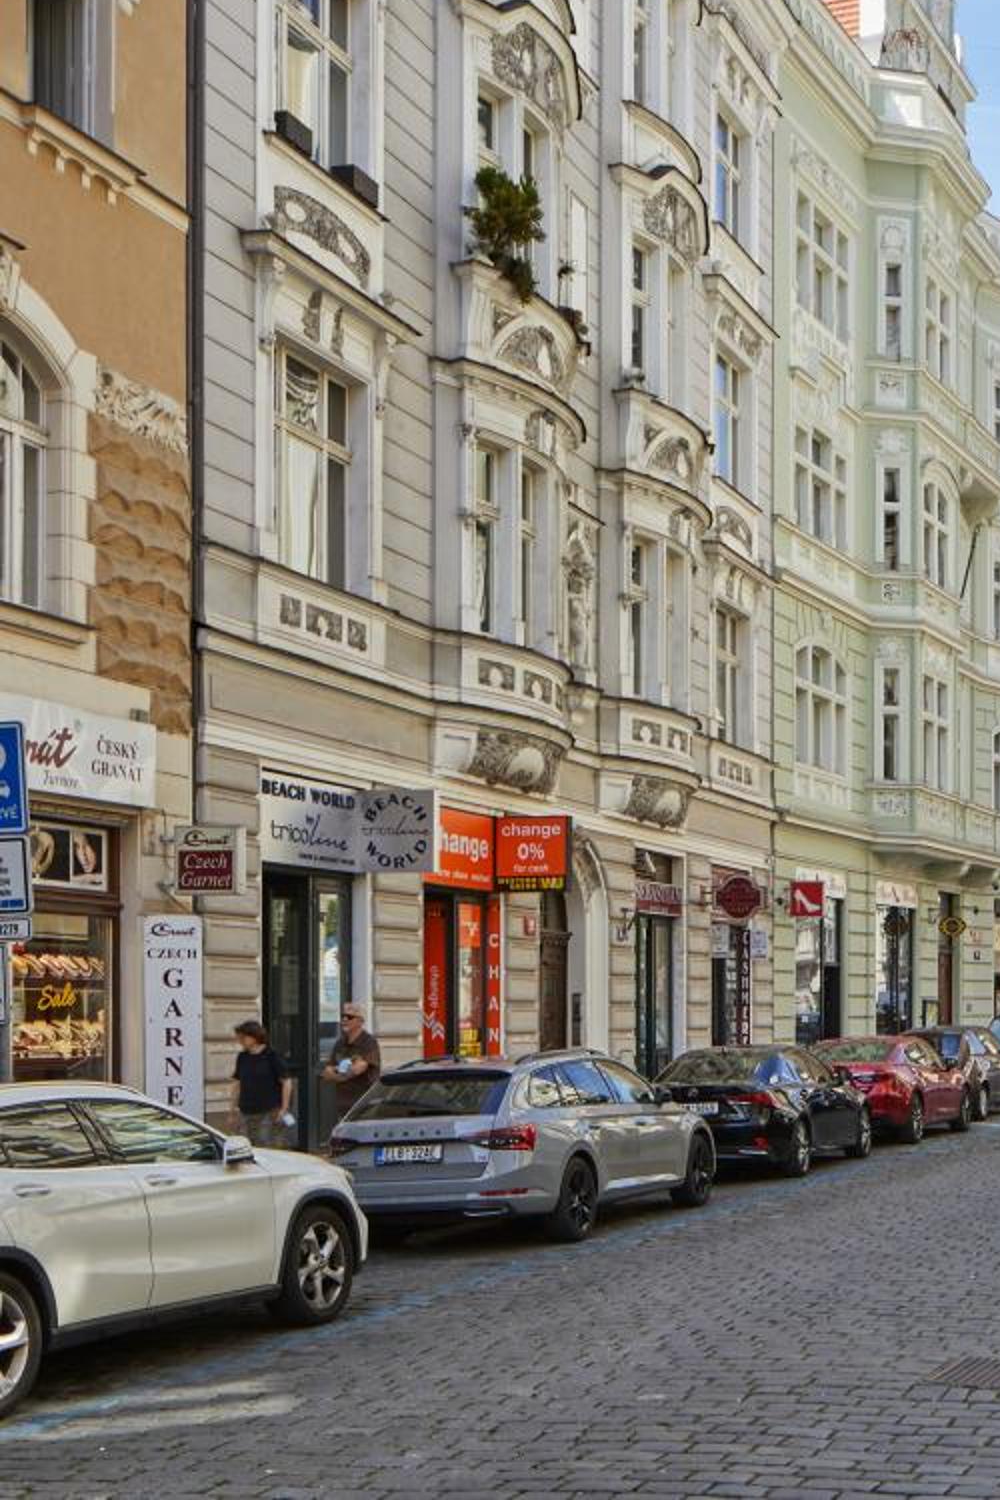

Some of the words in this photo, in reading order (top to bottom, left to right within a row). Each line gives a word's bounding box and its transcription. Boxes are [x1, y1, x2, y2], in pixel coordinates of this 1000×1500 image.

[97, 735, 139, 760] ČESKÝ
[91, 760, 143, 783] GRANÁT
[262, 778, 306, 801] BEACH
[310, 788, 355, 810] WORLD
[363, 793, 428, 823] BEACH
[501, 822, 562, 839] change
[184, 853, 228, 869] Czech
[366, 838, 428, 869] WORLD
[516, 842, 546, 861] 0%
[181, 872, 232, 888] Garnet
[147, 948, 197, 959] CZECH
[37, 981, 77, 1011] Sale
